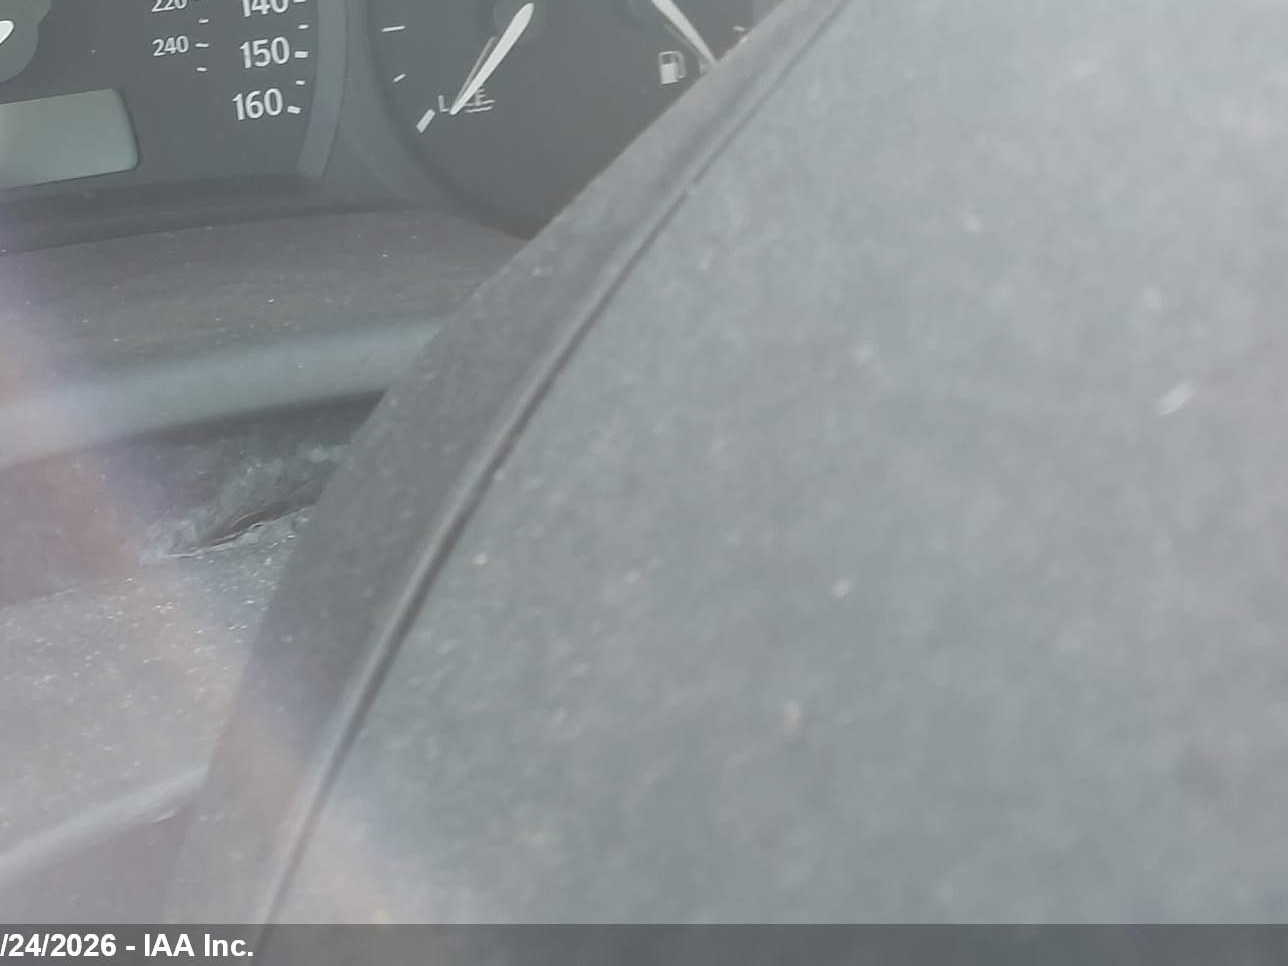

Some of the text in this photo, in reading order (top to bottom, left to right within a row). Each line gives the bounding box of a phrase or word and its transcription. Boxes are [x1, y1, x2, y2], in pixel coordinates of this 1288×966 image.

[152, 35, 189, 56] 240
[239, 37, 290, 68] 150
[232, 88, 283, 120] 160
[438, 95, 449, 113] L
